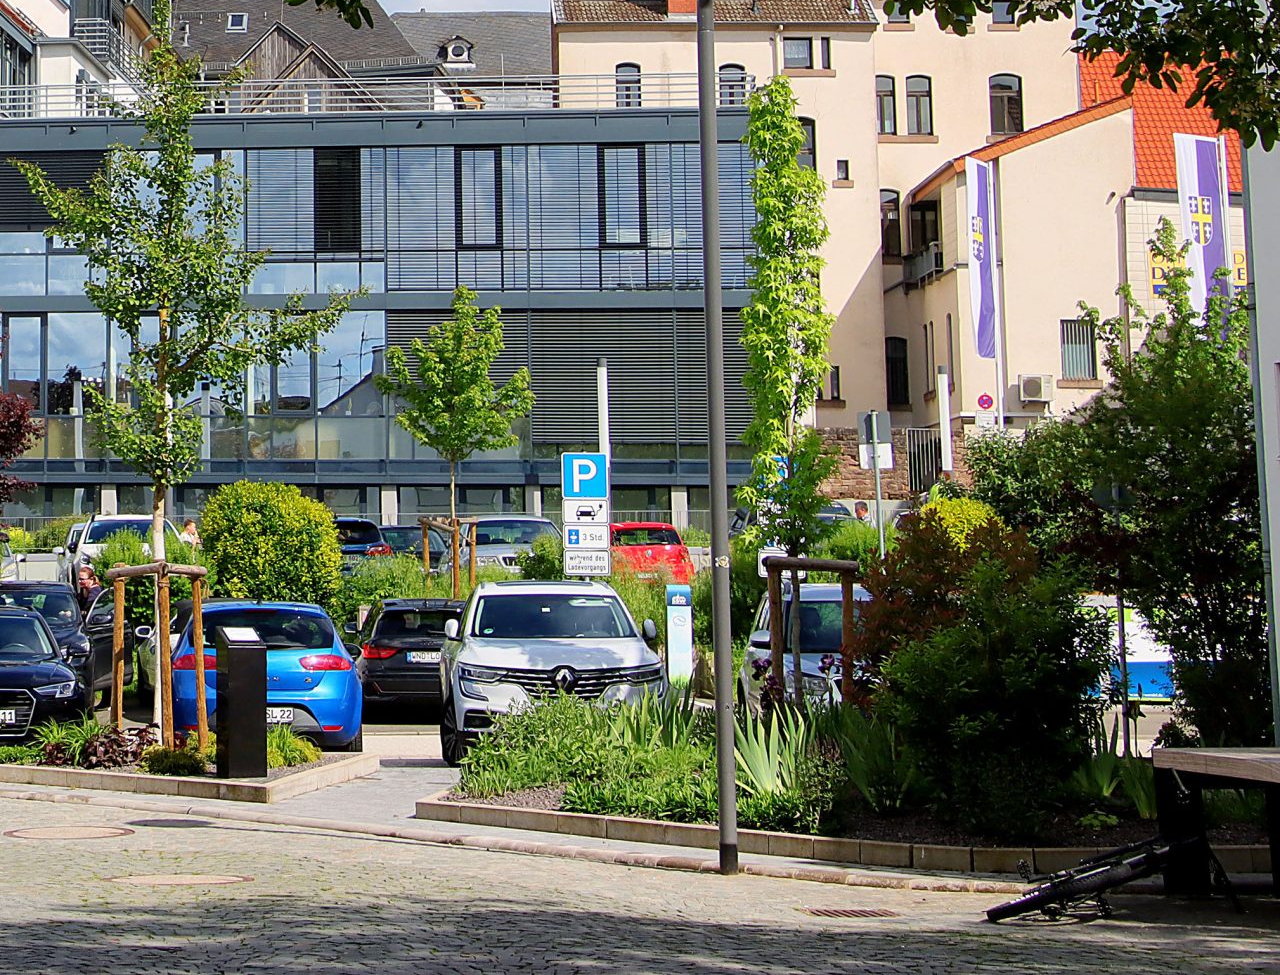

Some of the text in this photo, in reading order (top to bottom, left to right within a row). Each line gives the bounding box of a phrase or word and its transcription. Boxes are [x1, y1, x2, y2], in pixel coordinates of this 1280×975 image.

[572, 459, 597, 493] P
[582, 533, 587, 541] 3
[2, 711, 14, 722] 11
[280, 709, 292, 719] 22
